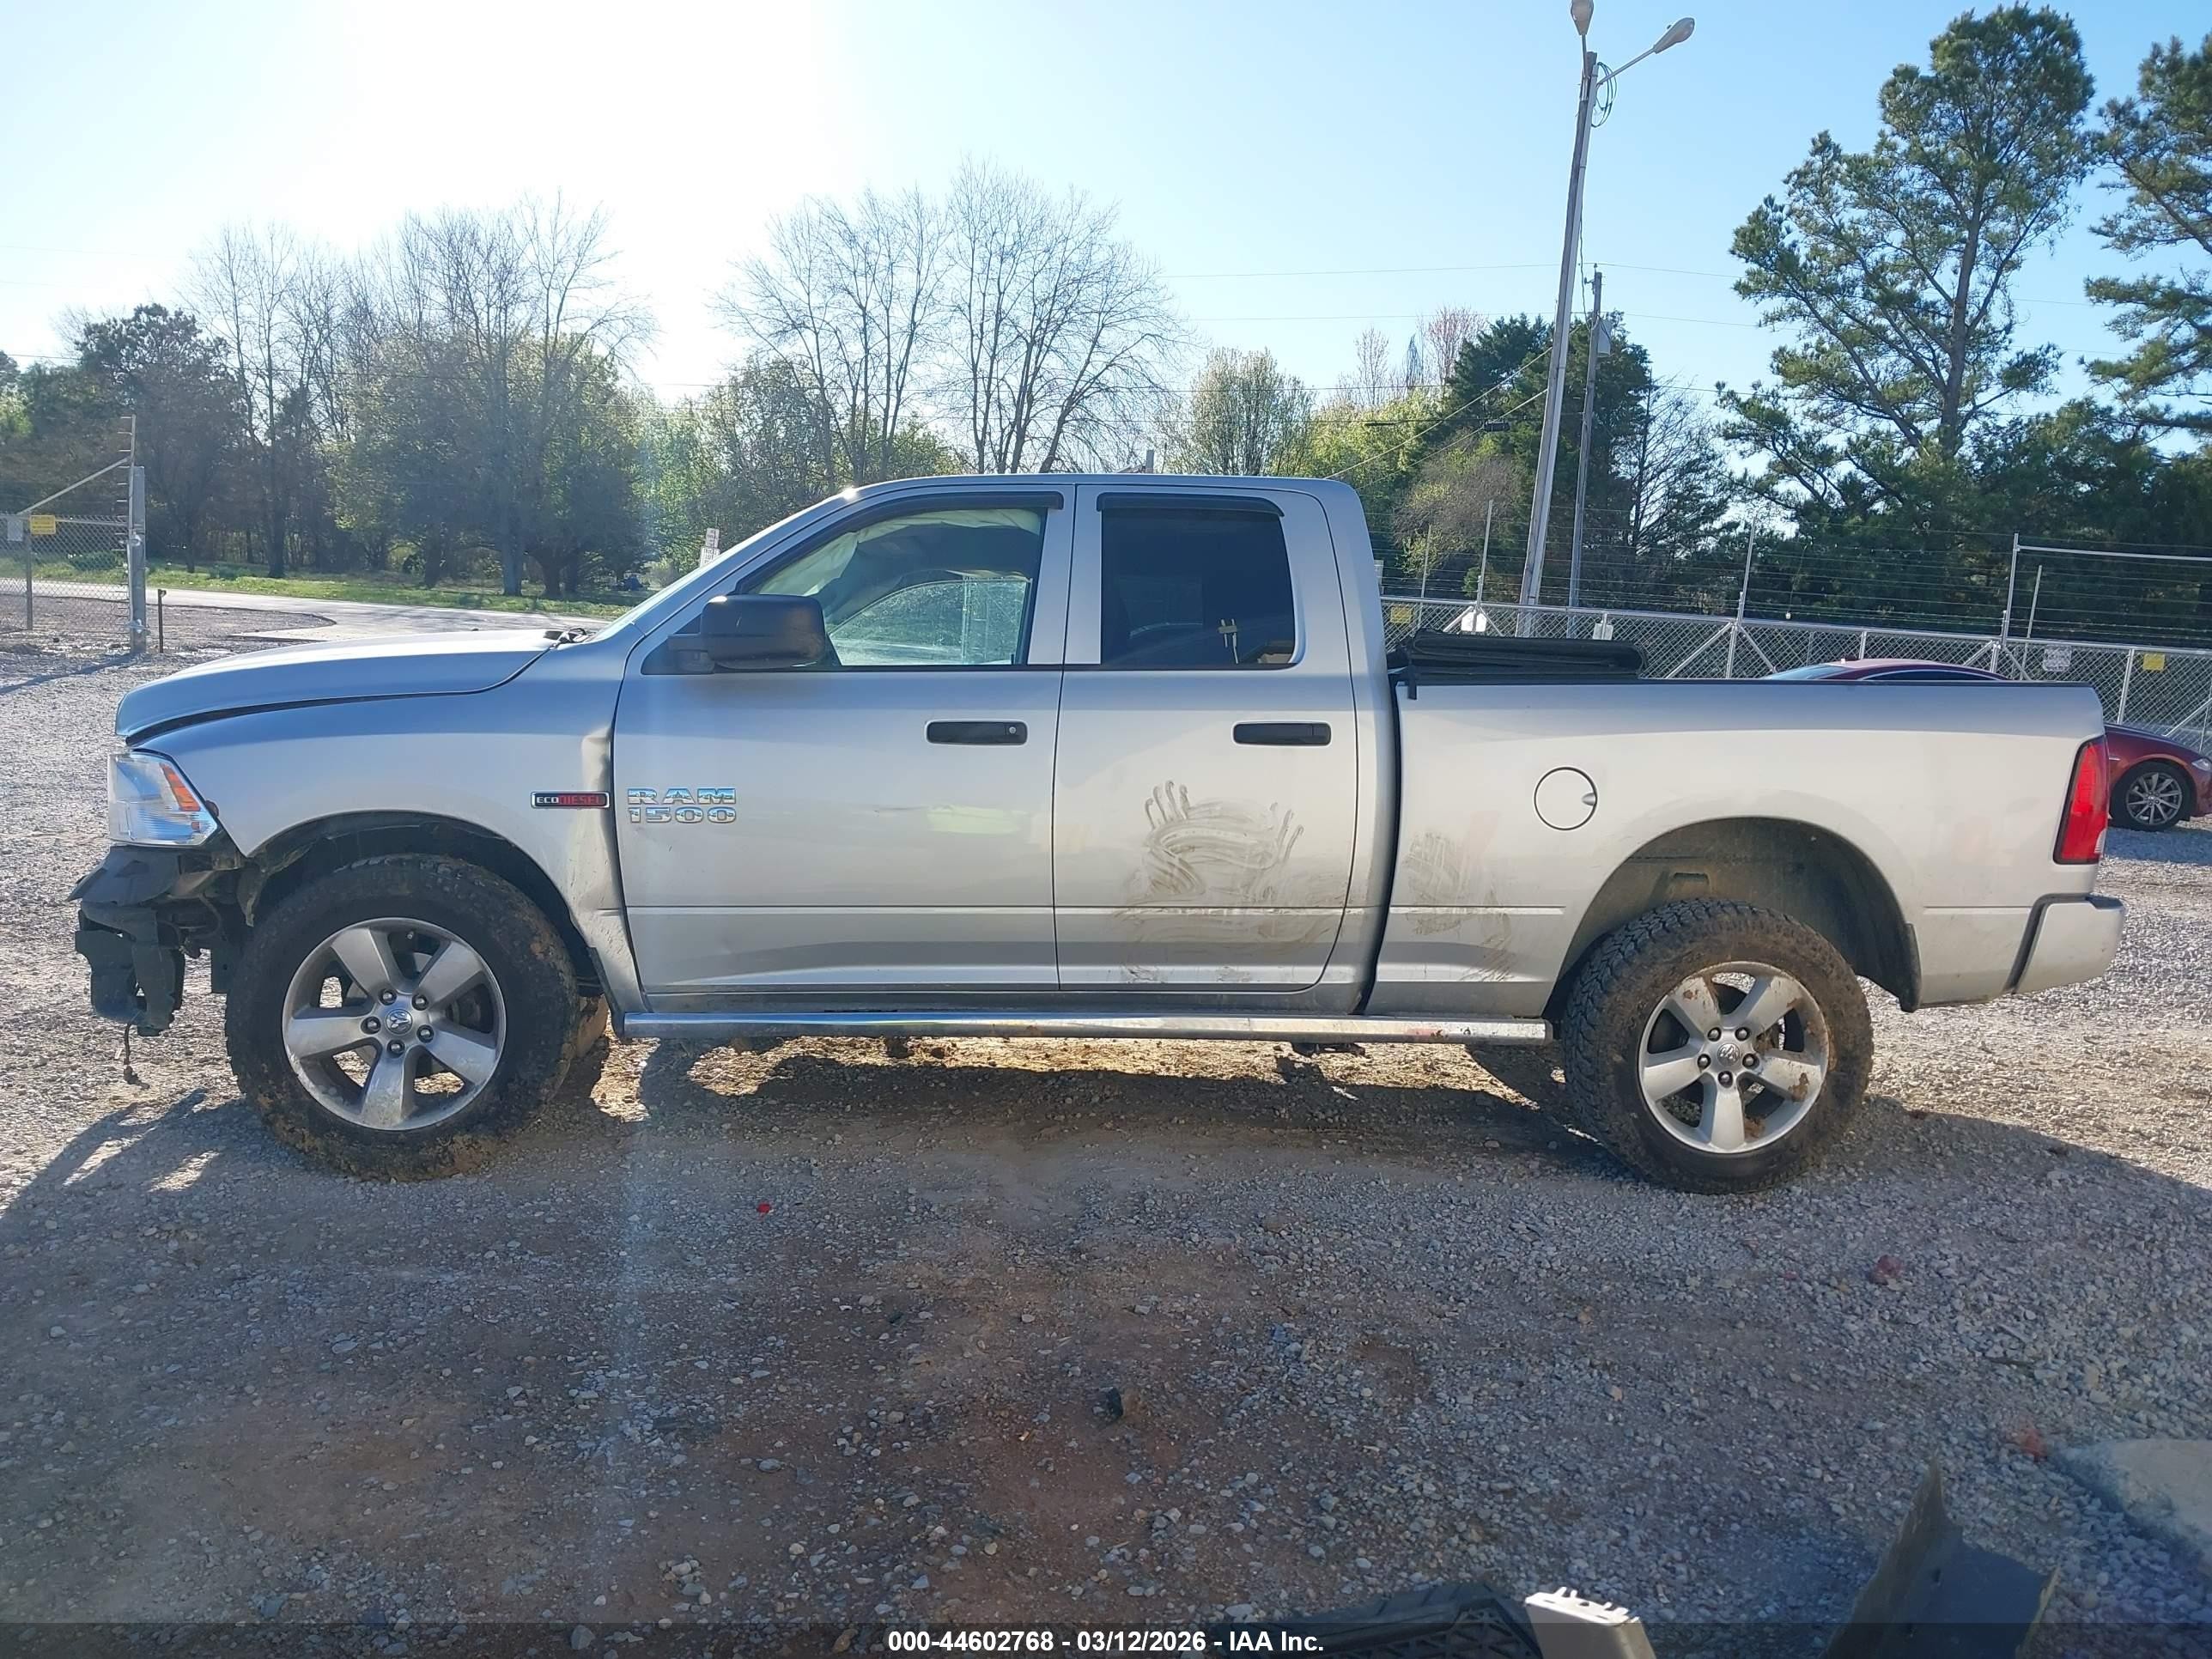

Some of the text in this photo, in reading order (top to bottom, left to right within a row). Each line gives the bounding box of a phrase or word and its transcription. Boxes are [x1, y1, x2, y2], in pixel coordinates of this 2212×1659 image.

[536, 795, 605, 805] ECODIESEL
[628, 787, 737, 805] RAM
[628, 806, 737, 824] 1500
